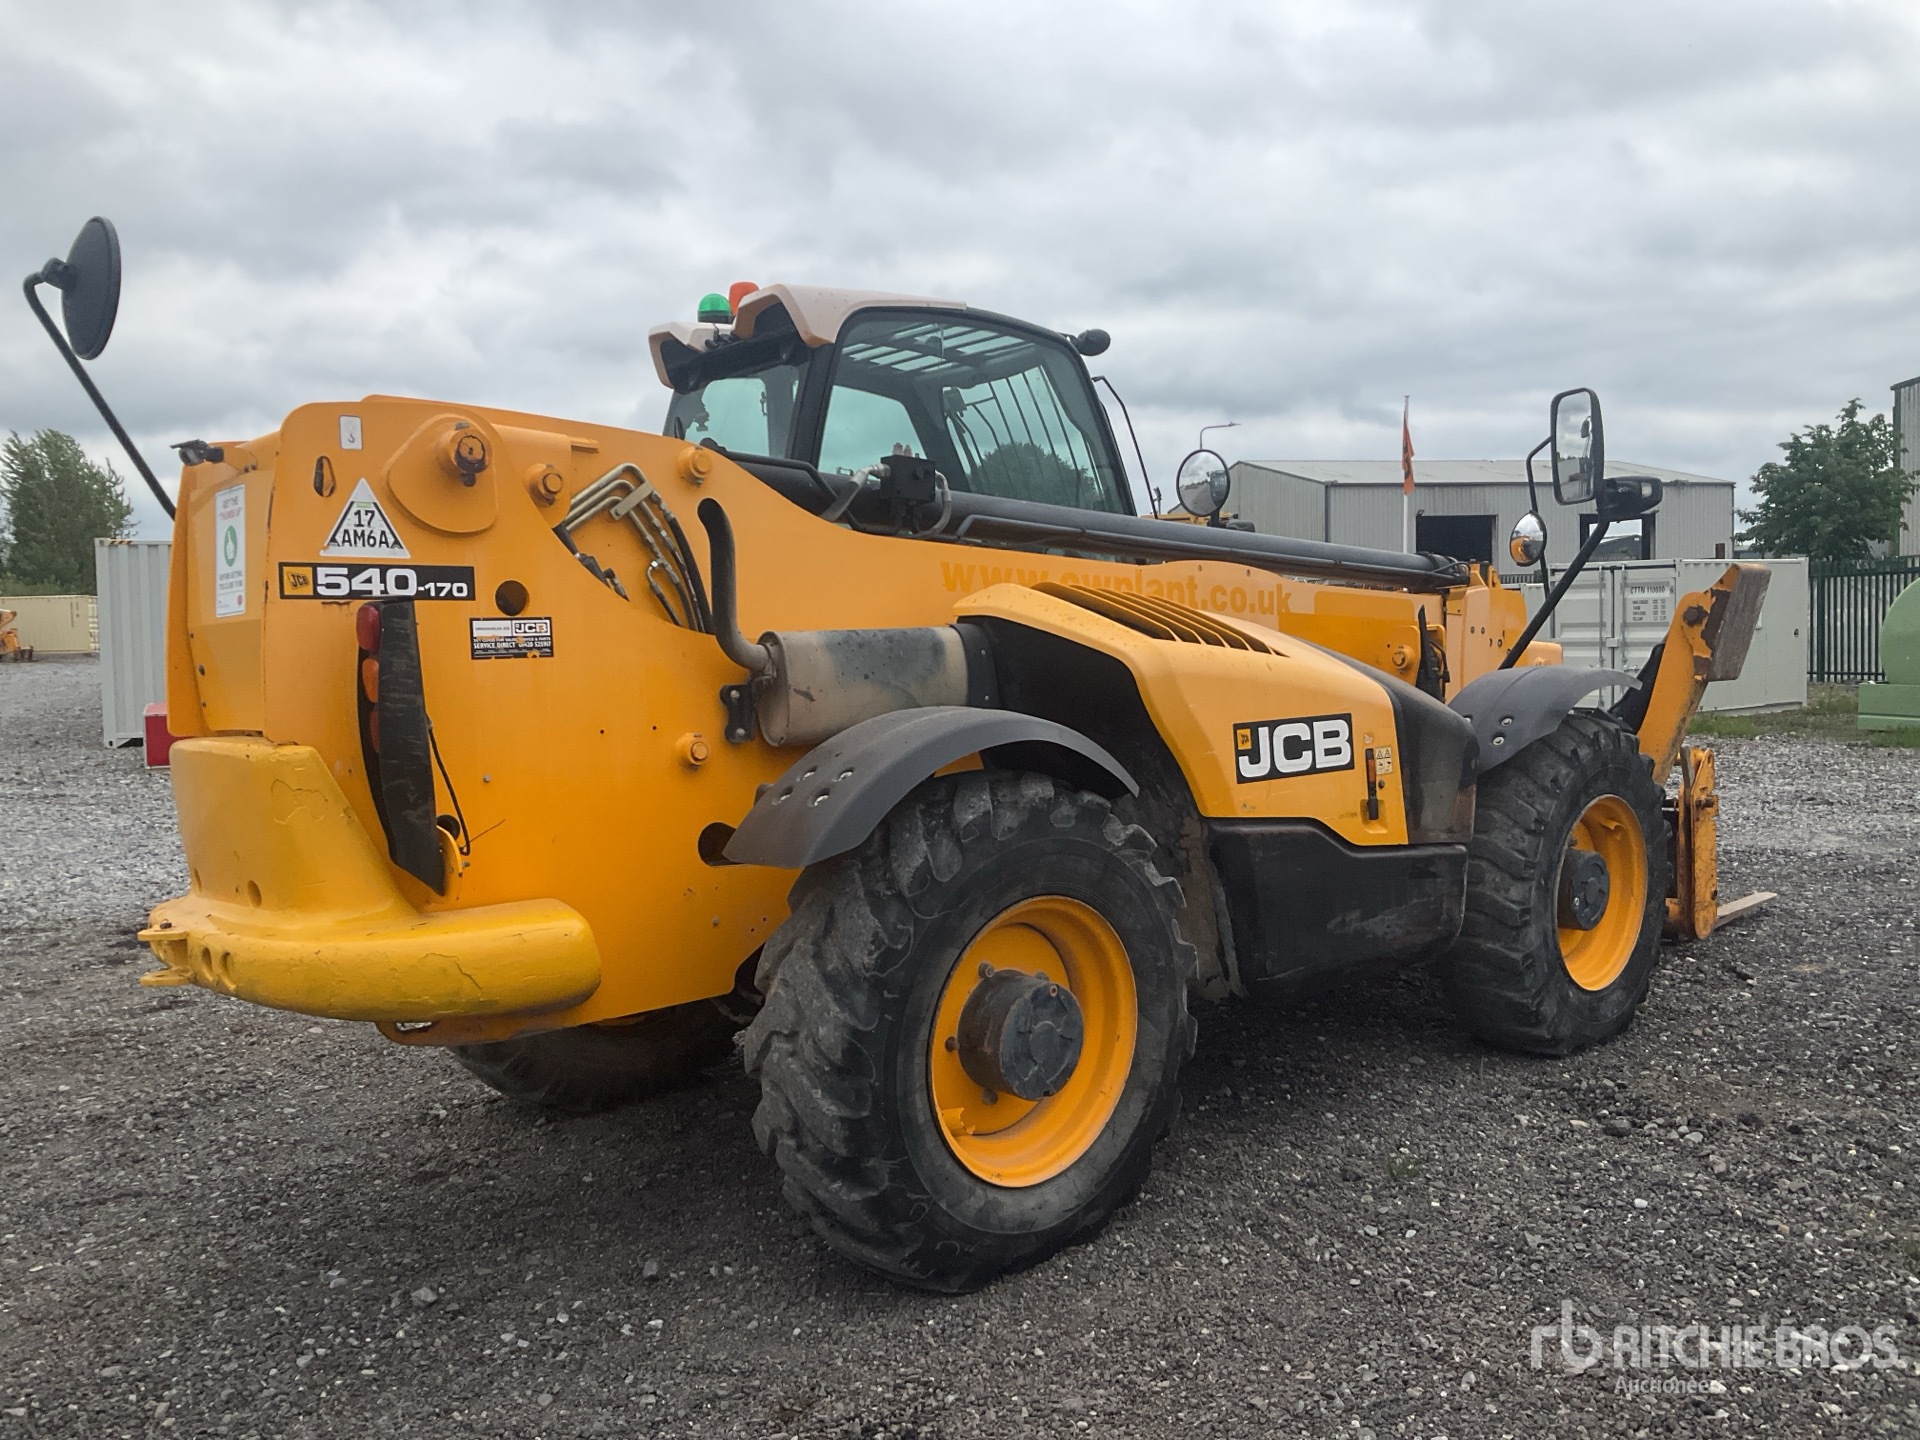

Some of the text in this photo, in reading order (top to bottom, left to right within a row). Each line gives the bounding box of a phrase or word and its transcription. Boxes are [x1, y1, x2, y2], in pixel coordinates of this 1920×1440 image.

[353, 509, 375, 528] 17
[341, 529, 390, 548] AM6A
[515, 623, 547, 633] JCB
[497, 641, 515, 649] DIRECT
[1238, 719, 1351, 778] JCB
